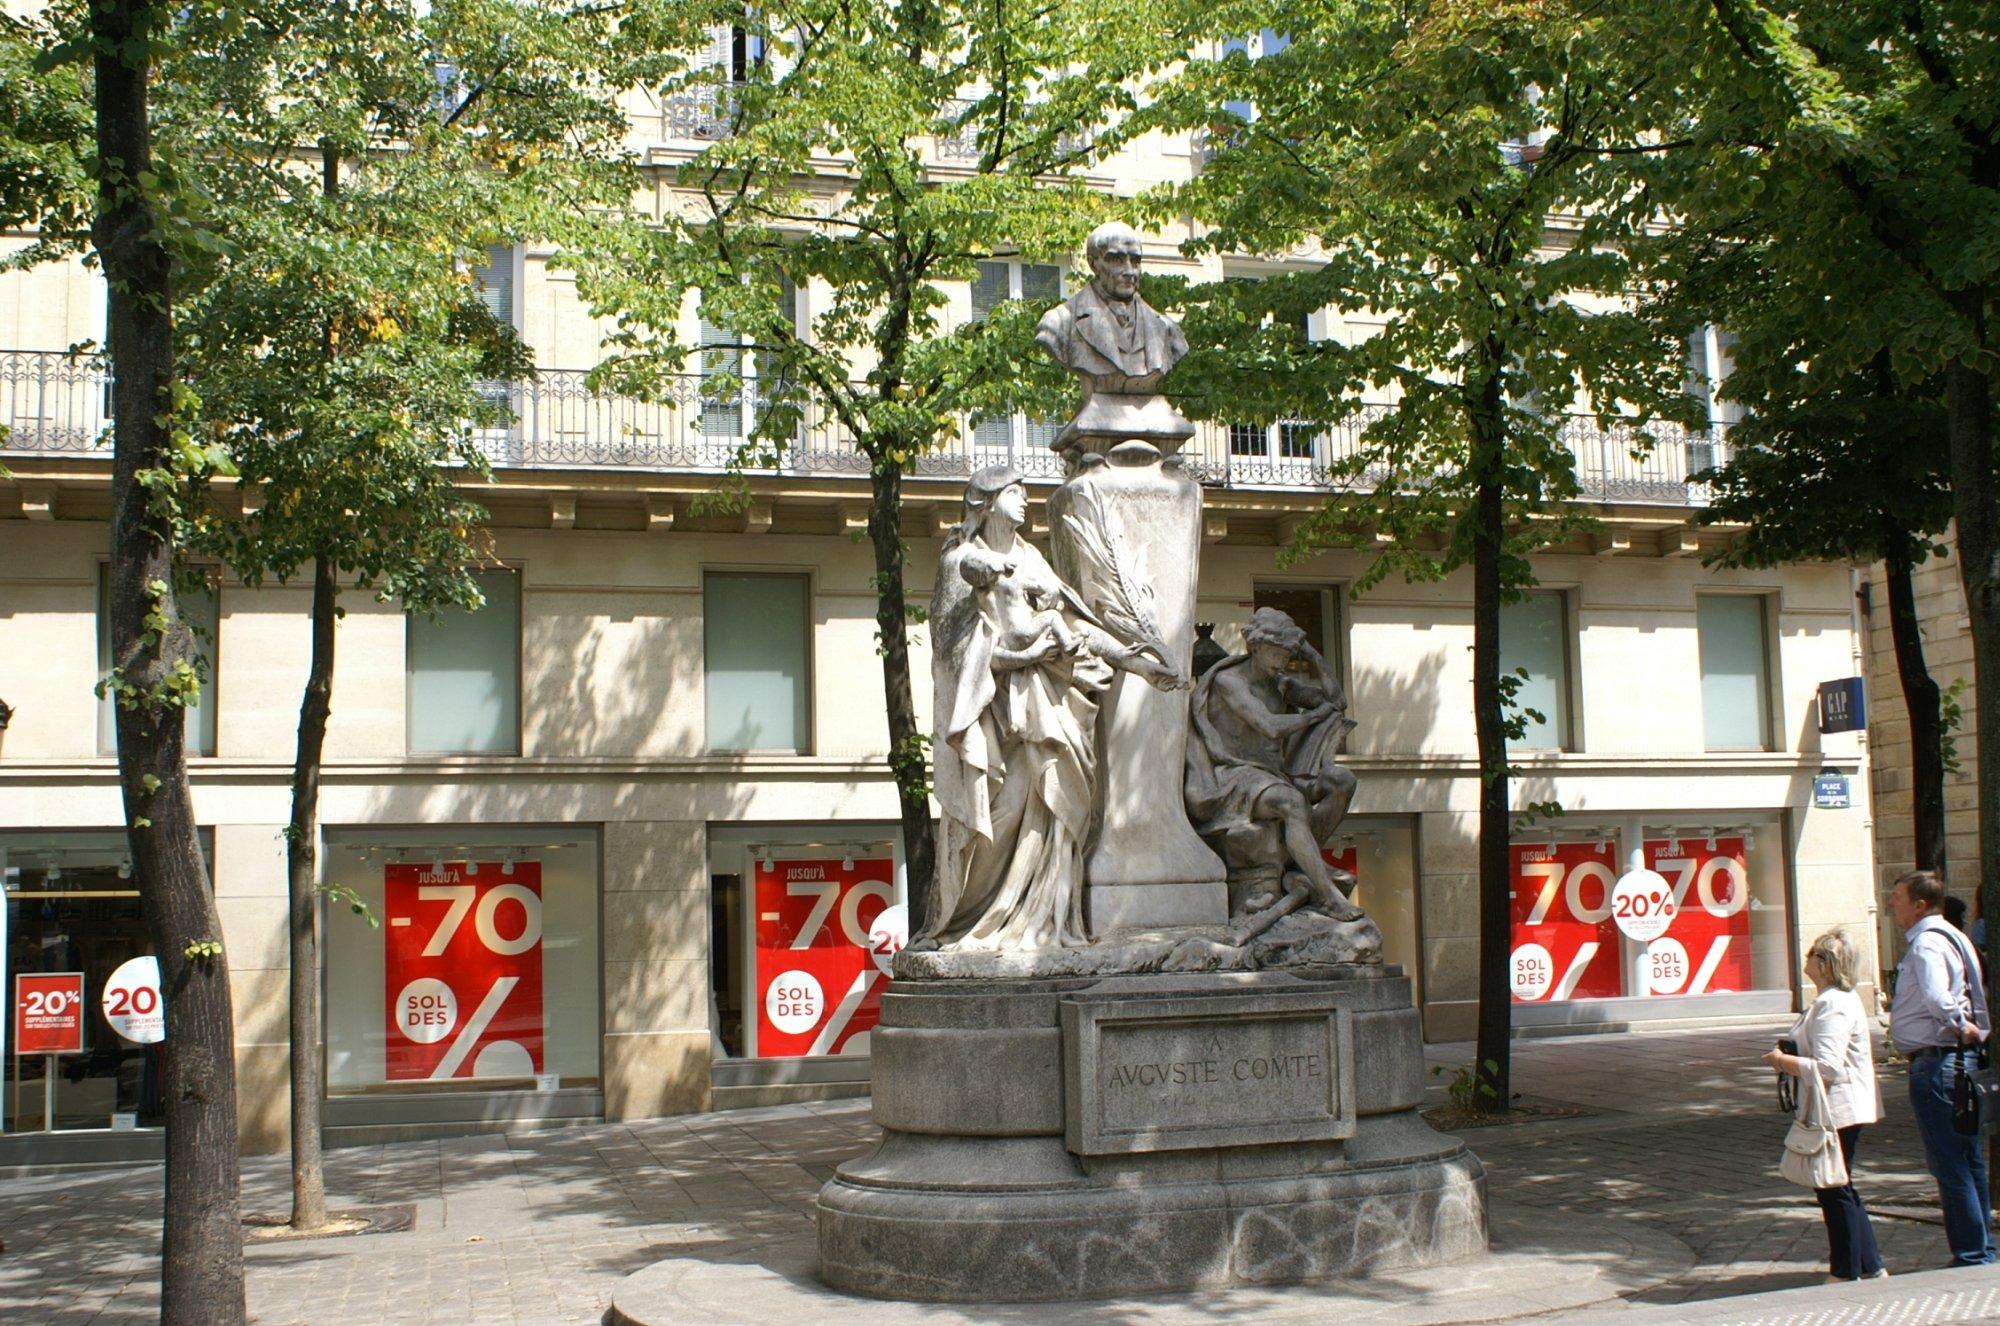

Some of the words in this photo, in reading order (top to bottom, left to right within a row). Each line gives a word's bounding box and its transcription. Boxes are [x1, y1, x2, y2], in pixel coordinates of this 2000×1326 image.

[1827, 690, 1847, 714] GAP
[1821, 782, 1841, 790] PLACE
[418, 869, 460, 884] JUSQU'À
[787, 868, 826, 880] JUSQU'À
[1611, 891, 1674, 918] -20%
[391, 883, 543, 957] -70
[761, 880, 894, 950] -70
[1516, 959, 1546, 971] SOL
[1652, 952, 1681, 964] SOL
[1516, 972, 1546, 986] DES
[1653, 965, 1682, 979] DES
[777, 987, 815, 1001] SOL
[20, 990, 81, 1016] -20%
[407, 995, 447, 1010] SOL
[778, 1002, 814, 1017] DES
[408, 1011, 447, 1026] DES
[1108, 1060, 1219, 1089] AVGVSTE
[1233, 1054, 1322, 1082] COMTE
